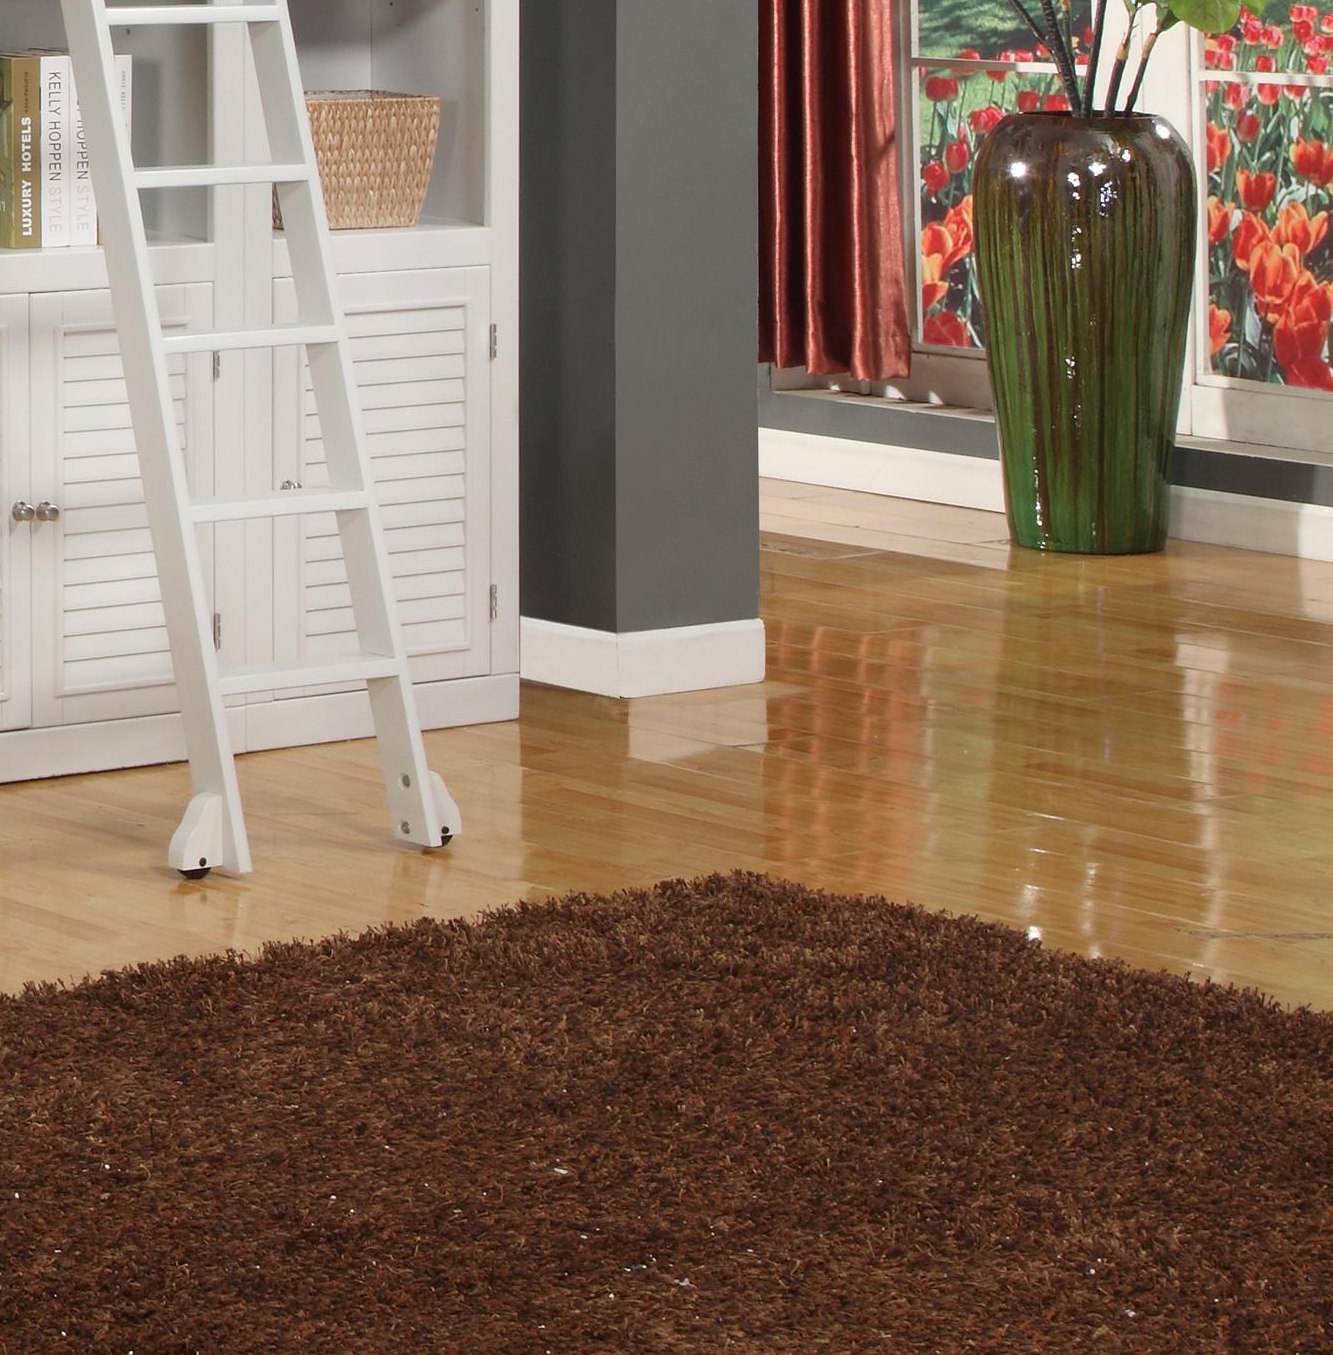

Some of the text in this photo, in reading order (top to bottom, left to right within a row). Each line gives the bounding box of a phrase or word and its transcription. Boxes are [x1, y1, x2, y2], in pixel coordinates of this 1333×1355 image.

[21, 116, 32, 236] LUXURY HOTELS
[48, 72, 61, 233] KELLY HOPPEN STYLE
[77, 186, 89, 231] STYLE
